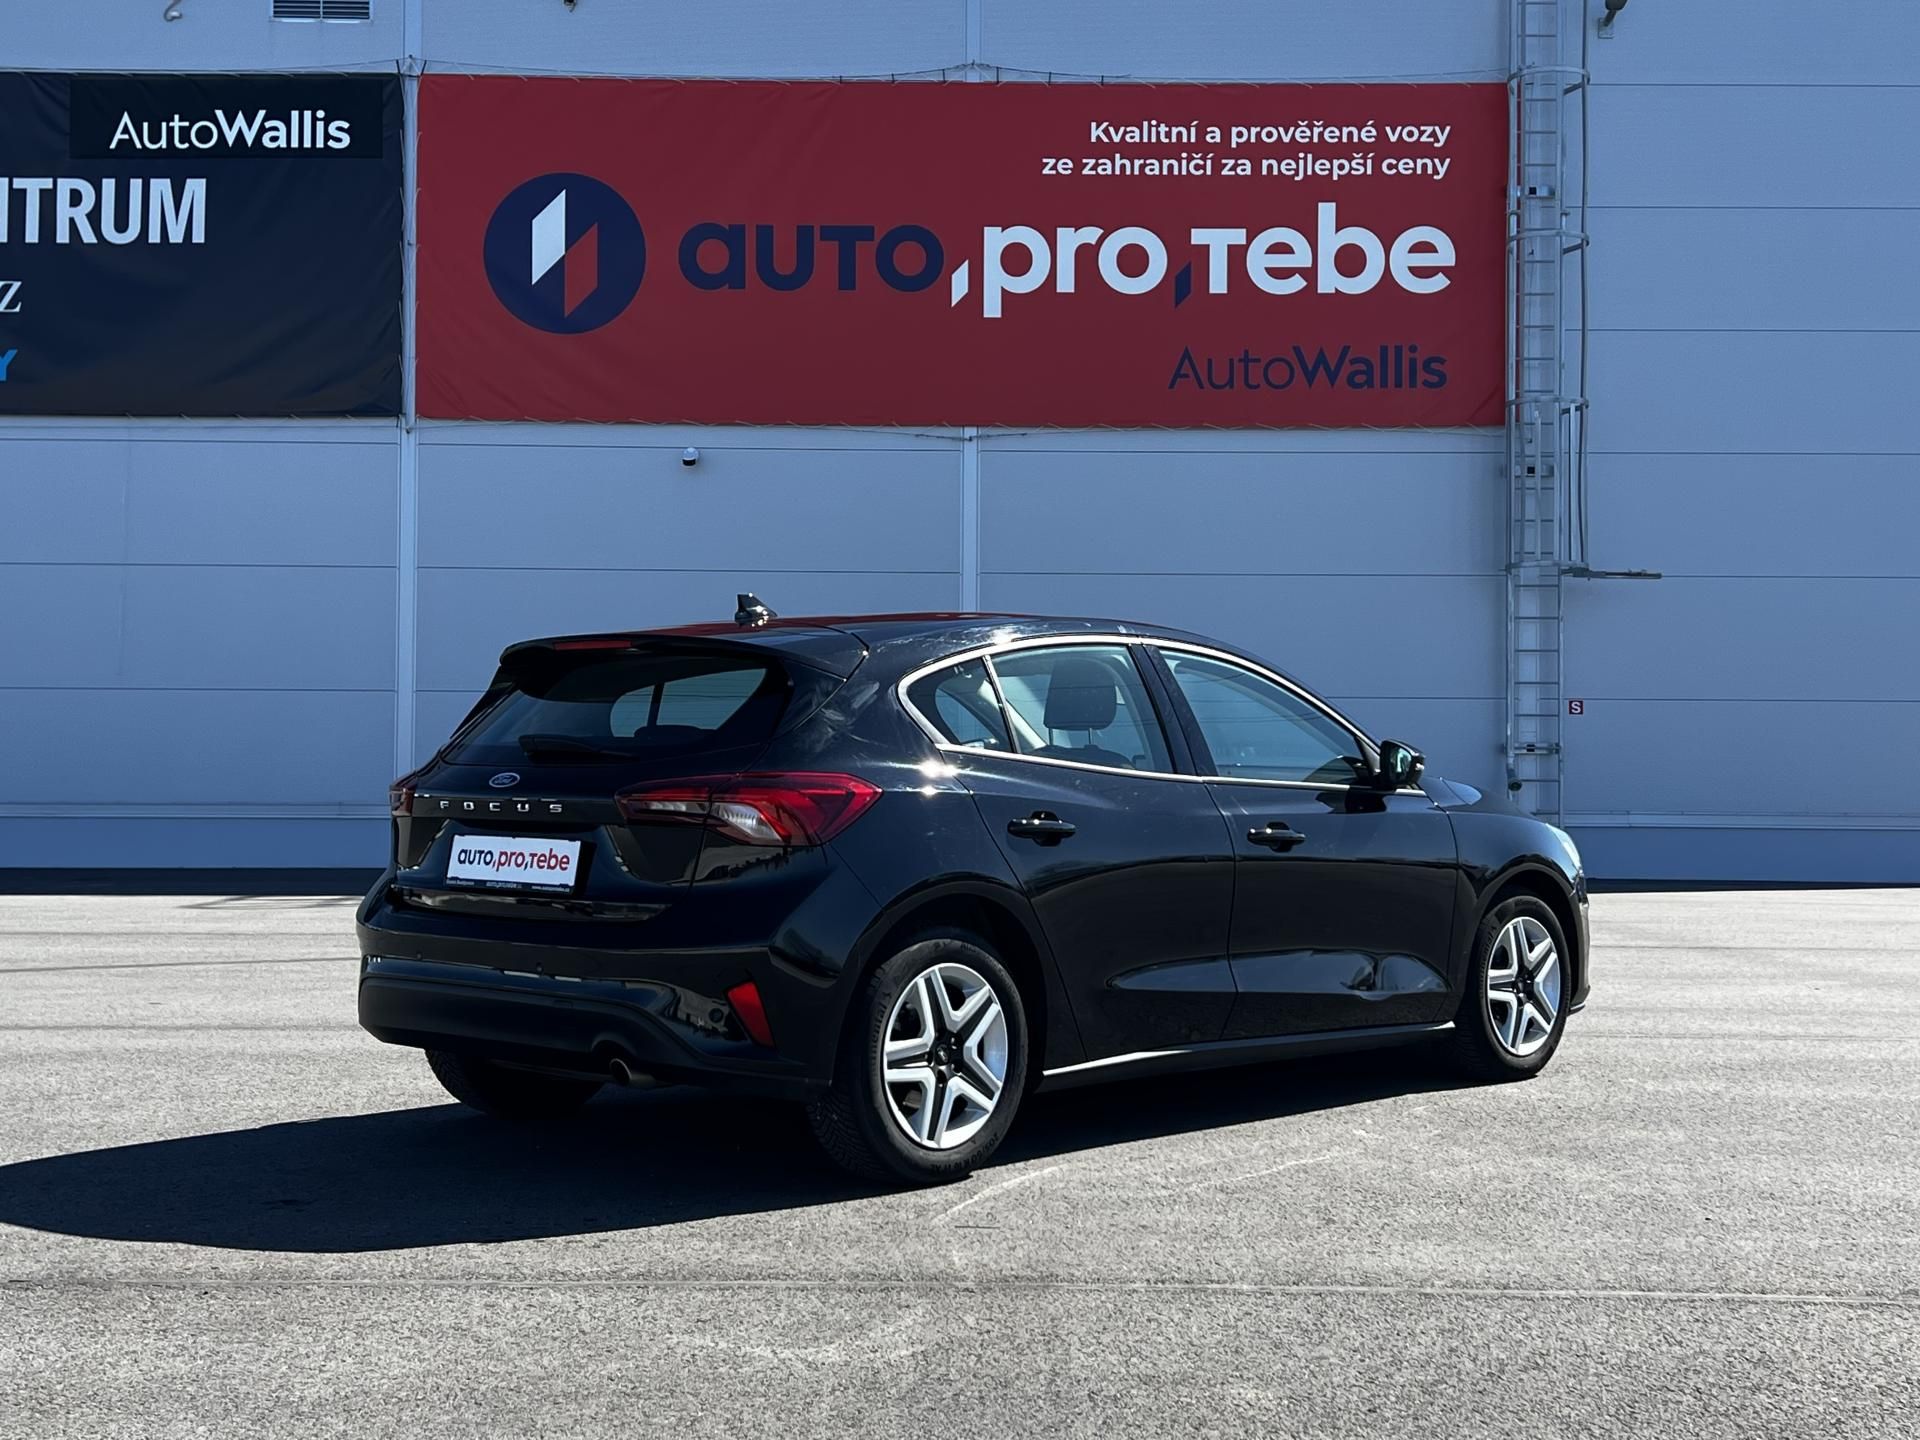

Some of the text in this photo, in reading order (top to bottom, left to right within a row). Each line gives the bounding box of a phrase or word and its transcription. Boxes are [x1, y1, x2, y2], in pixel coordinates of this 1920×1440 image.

[109, 109, 351, 150] AutoWallis
[1090, 120, 1451, 148] Kvalitní a prověřené vozy
[1041, 152, 1451, 180] ze zahraničí za nejlepší ceny
[0, 177, 207, 245] TRUM
[1168, 344, 1448, 390] AutoWallis
[1571, 701, 1581, 714] S
[440, 801, 563, 813] FOCUS
